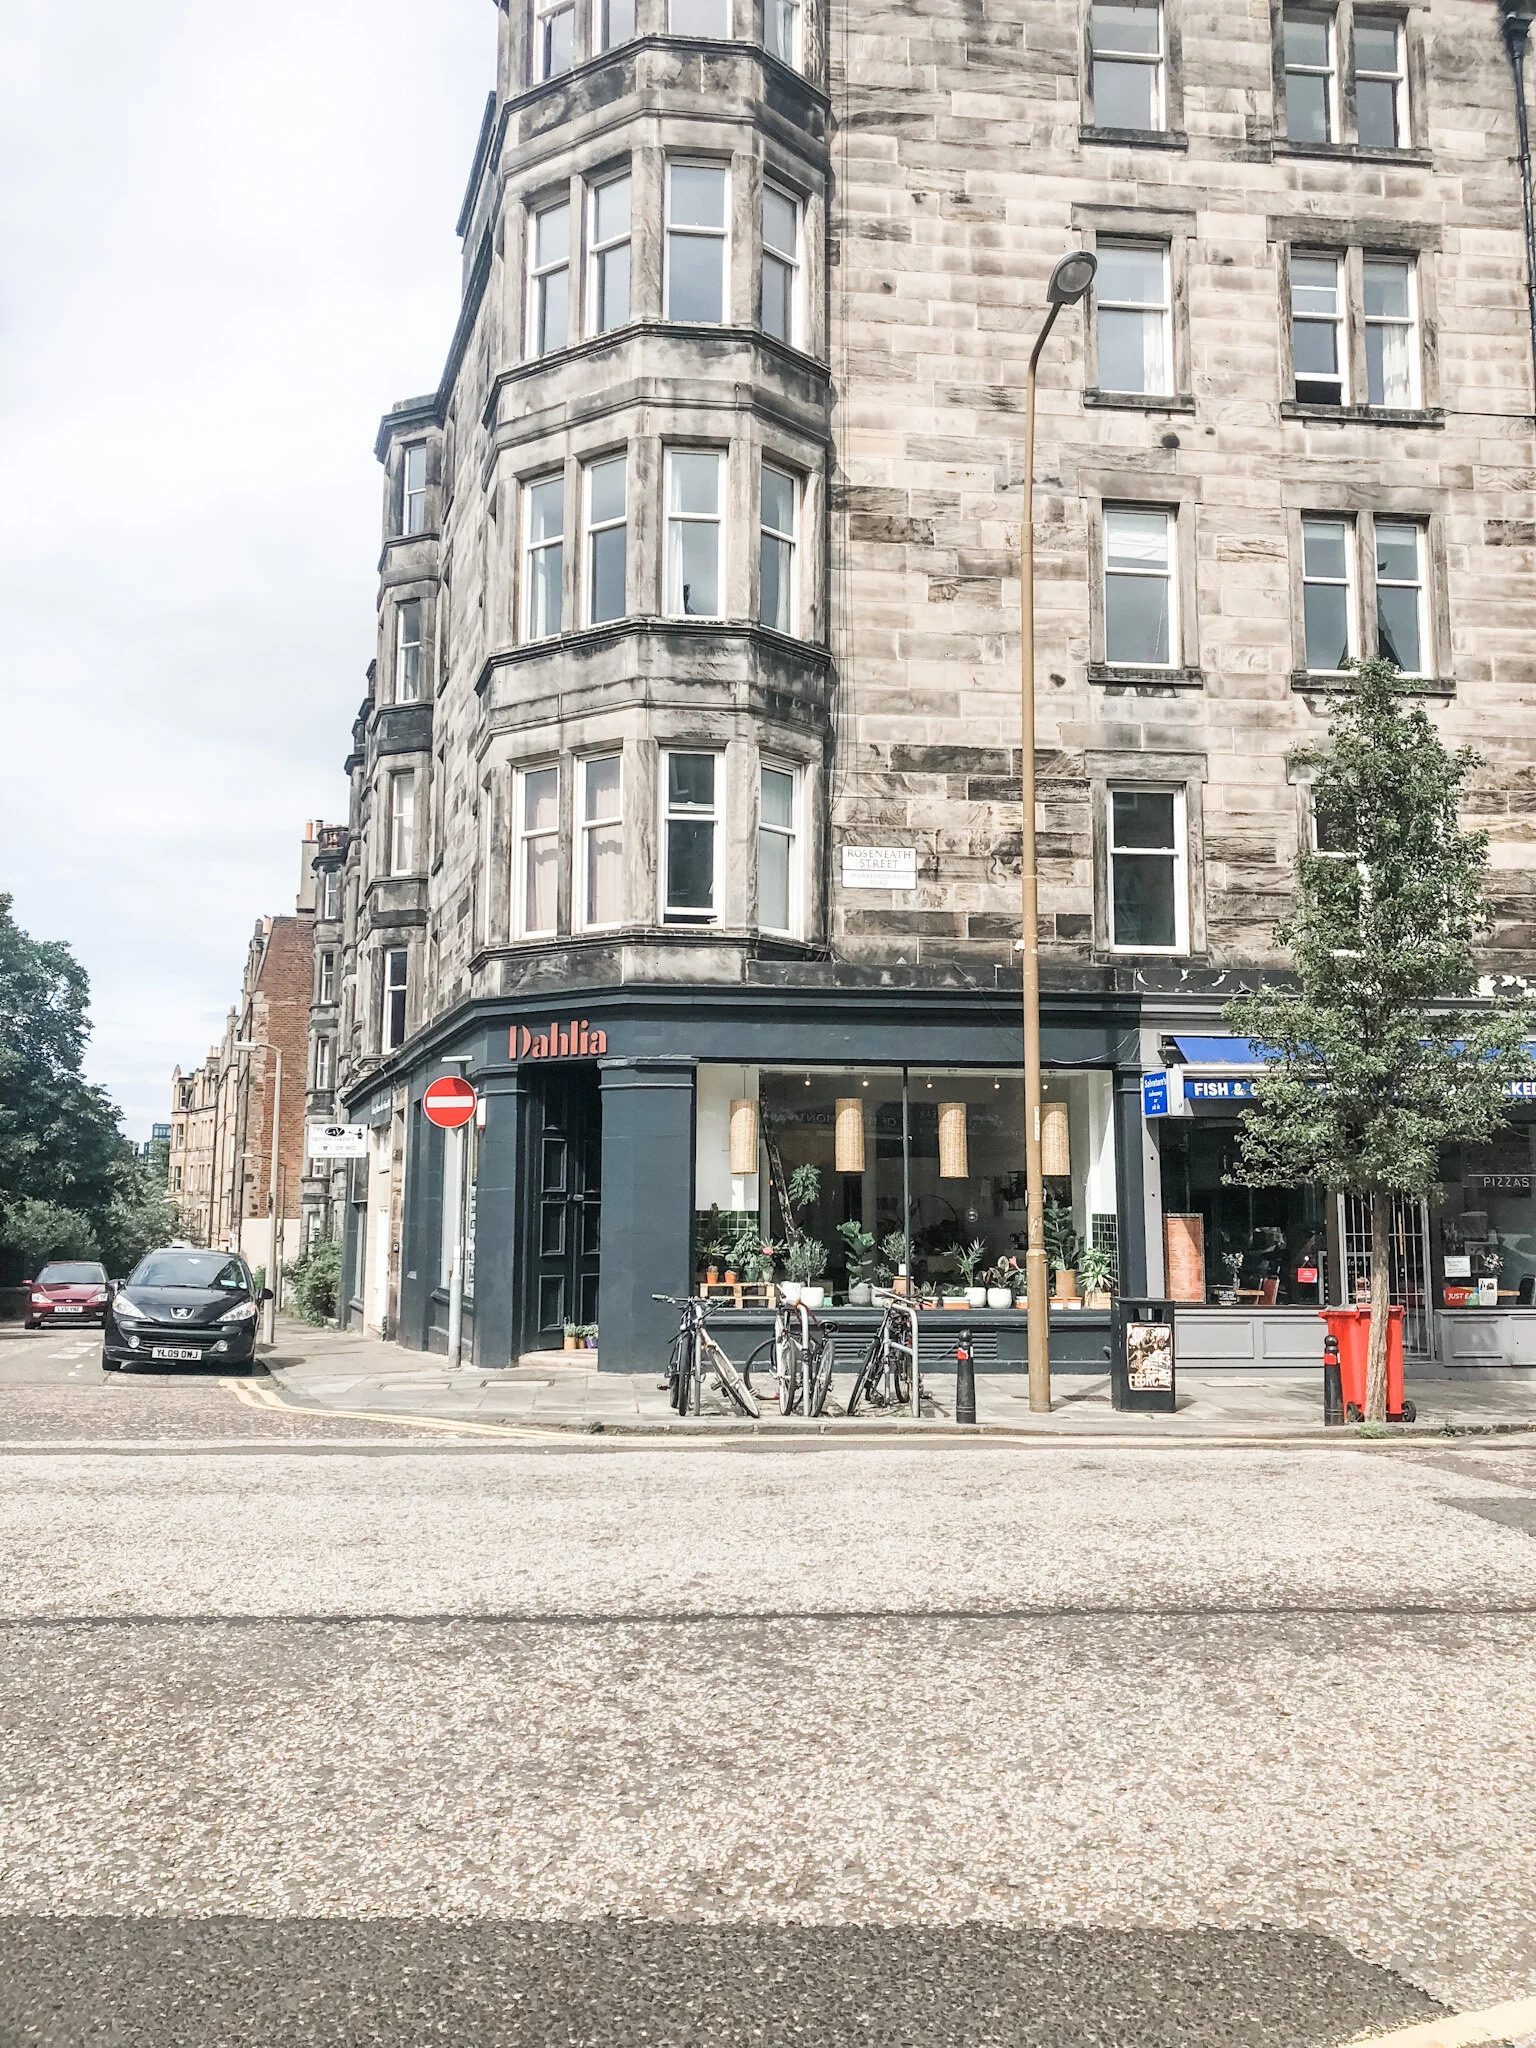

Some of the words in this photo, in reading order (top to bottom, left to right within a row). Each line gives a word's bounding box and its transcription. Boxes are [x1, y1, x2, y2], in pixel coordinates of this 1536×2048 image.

[847, 849, 911, 859] ROSENEATH
[860, 858, 899, 868] STREET
[508, 1019, 607, 1059] Dahlia
[1194, 1082, 1229, 1096] FISH
[1233, 1082, 1247, 1096] &
[1483, 1176, 1530, 1188] PIZZAS
[1447, 1292, 1465, 1301] JUST
[1464, 1292, 1479, 1300] EAT
